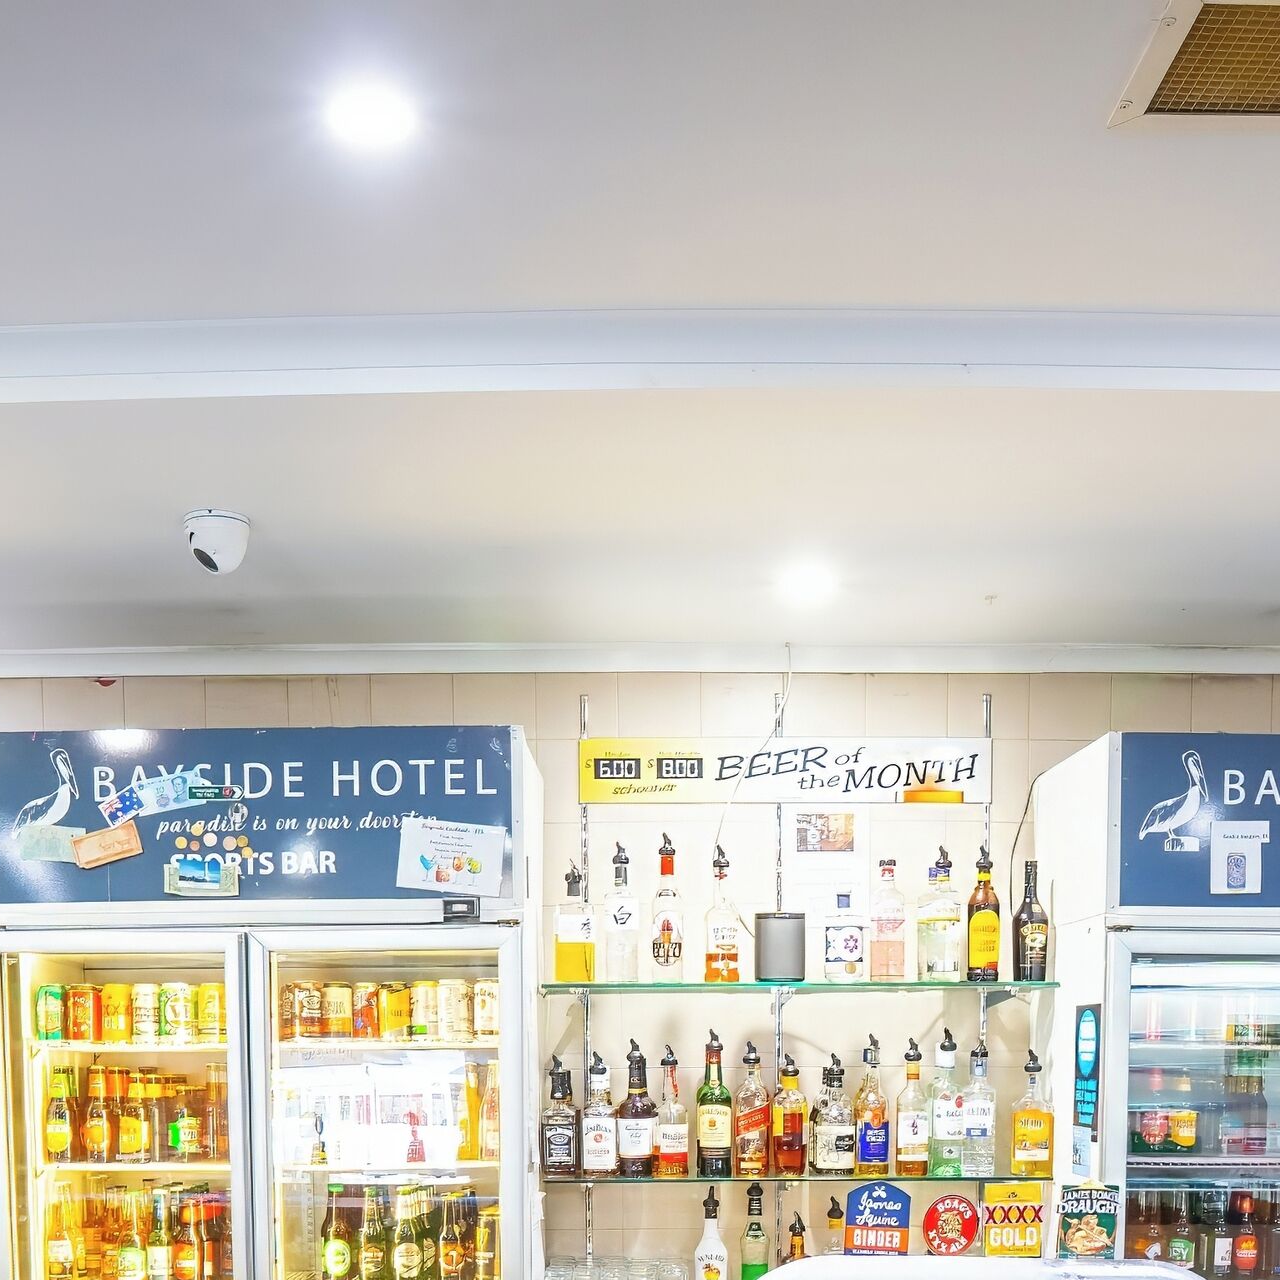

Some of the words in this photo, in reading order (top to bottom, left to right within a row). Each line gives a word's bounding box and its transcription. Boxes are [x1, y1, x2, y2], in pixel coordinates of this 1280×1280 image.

[715, 746, 828, 781] BEER
[835, 747, 866, 766] of
[797, 774, 840, 791] the
[842, 753, 979, 793] MONTH
[332, 758, 497, 799] HOTEL
[253, 815, 267, 831] is
[276, 816, 297, 832] on
[306, 813, 351, 837] your
[356, 809, 437, 831] doort
[281, 851, 336, 875] BAR
[613, 904, 631, 925] 白
[858, 1191, 902, 1211] James
[1062, 1190, 1090, 1203] JAMES
[985, 1205, 1043, 1224] XXXX
[989, 1226, 1037, 1248] GOLD
